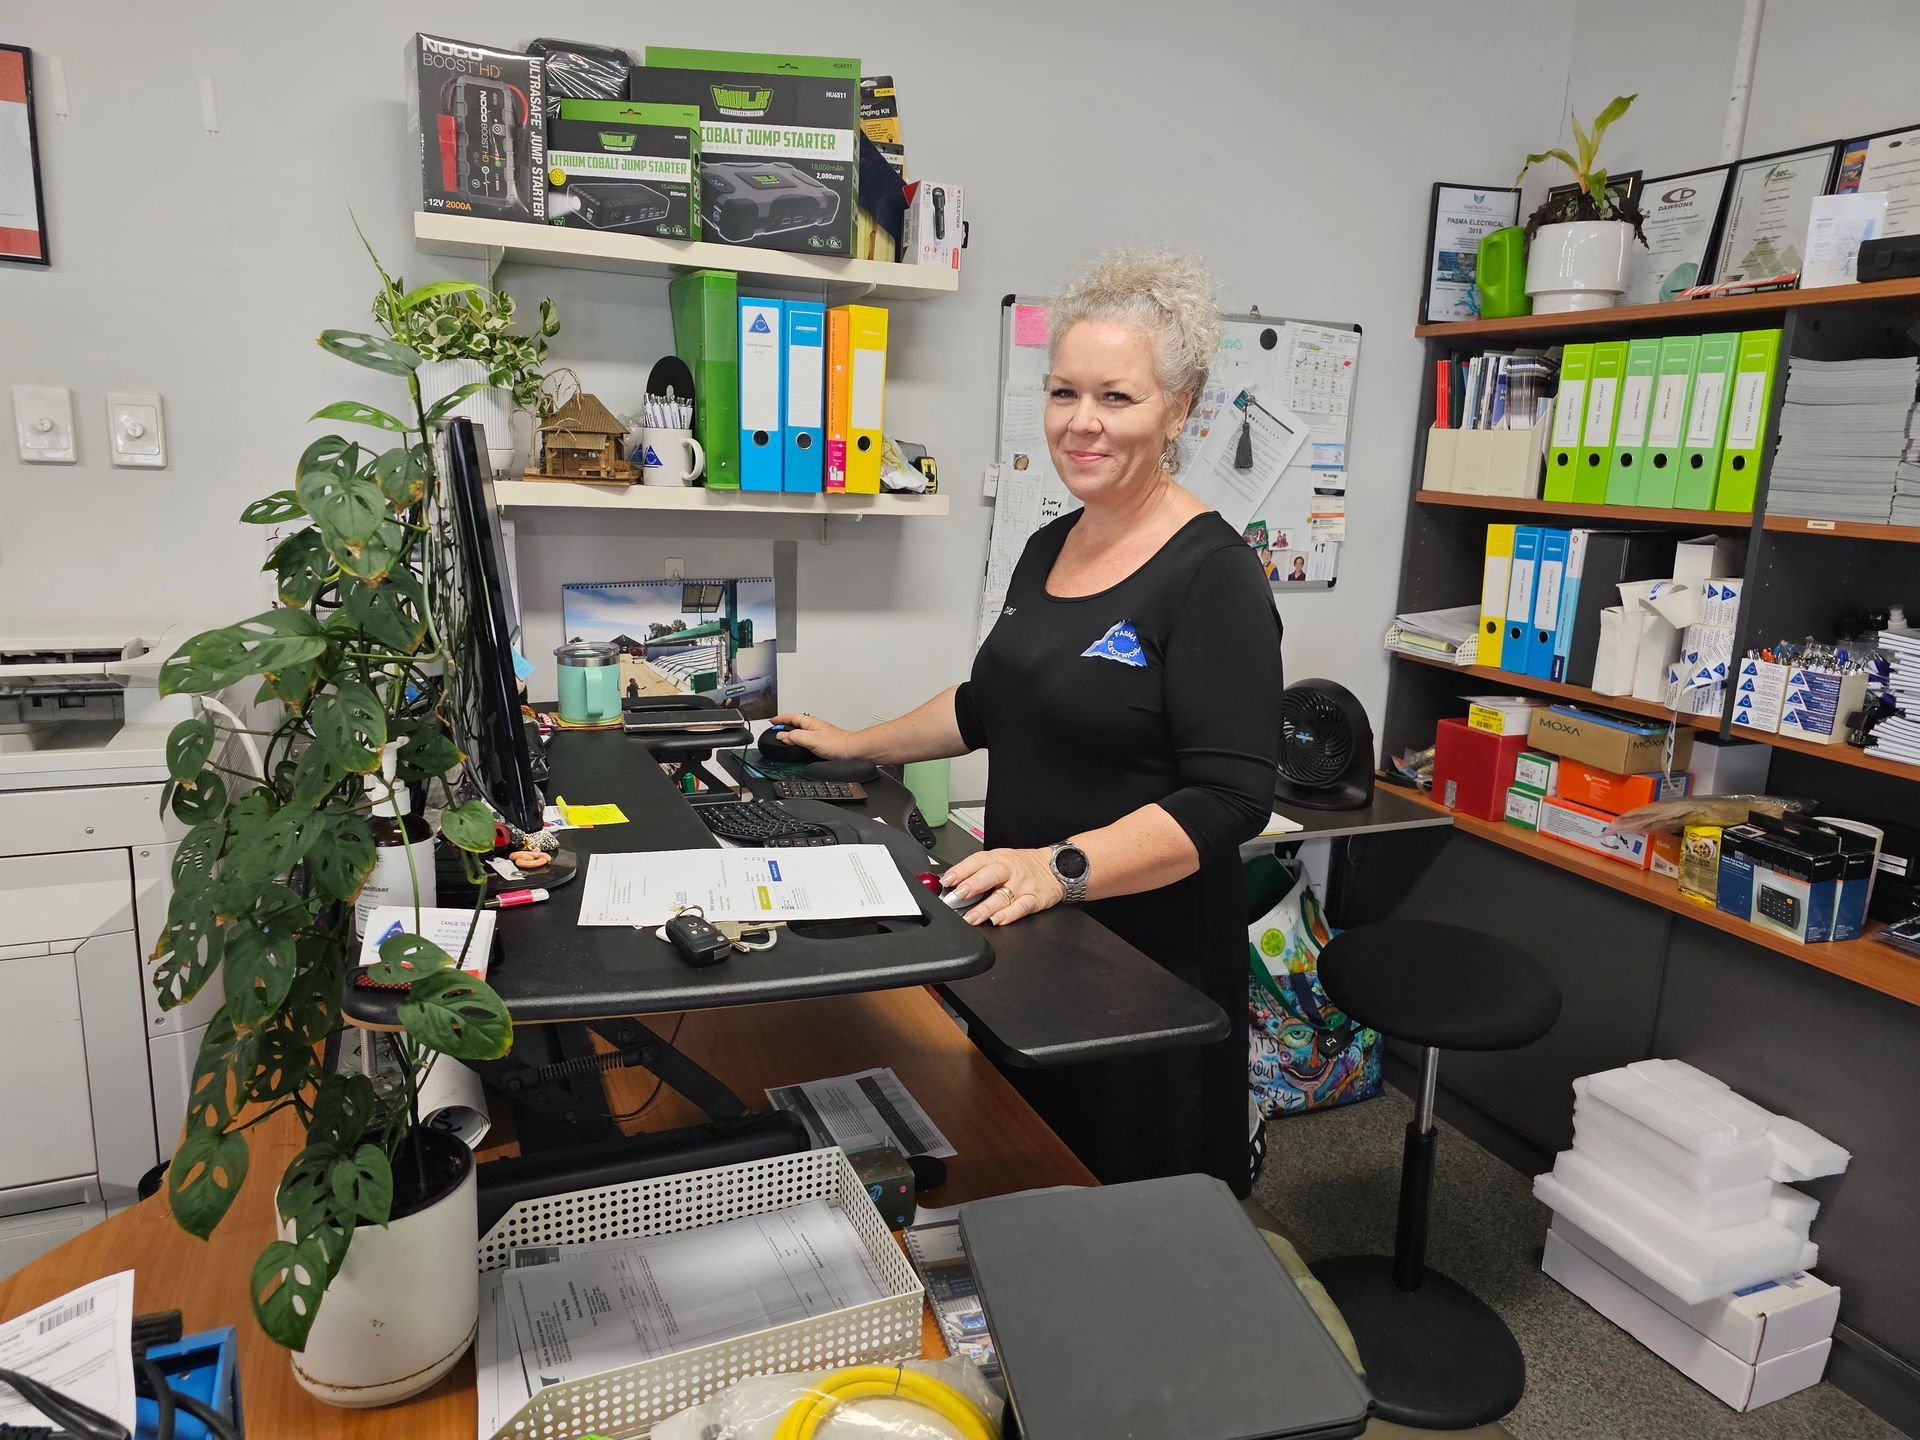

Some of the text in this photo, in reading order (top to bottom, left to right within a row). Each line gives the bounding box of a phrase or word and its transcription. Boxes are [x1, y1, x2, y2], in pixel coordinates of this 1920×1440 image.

[422, 38, 483, 61] NOCO
[423, 53, 501, 78] BOOST HD
[714, 88, 771, 109] HULK
[825, 91, 847, 99] HU6511
[481, 123, 489, 152] BOOST
[529, 60, 545, 217] ULTRASAFE JUMP STARTER
[701, 127, 836, 150] COBALT JUMP STARTER
[550, 154, 687, 174] LITHIUM COBALT JUMP STARTER
[816, 173, 844, 181] 2,000amp
[428, 198, 472, 211] 12V 2000A
[1658, 201, 1694, 212] DAWSONS
[1447, 217, 1505, 228] PASMA ELECTRICAL
[1114, 630, 1138, 643] PASMA
[1107, 640, 1141, 658] ELECTRICAL
[1539, 717, 1580, 737] MOXA
[1633, 739, 1666, 749] MOXA
[362, 885, 390, 893] anitiser
